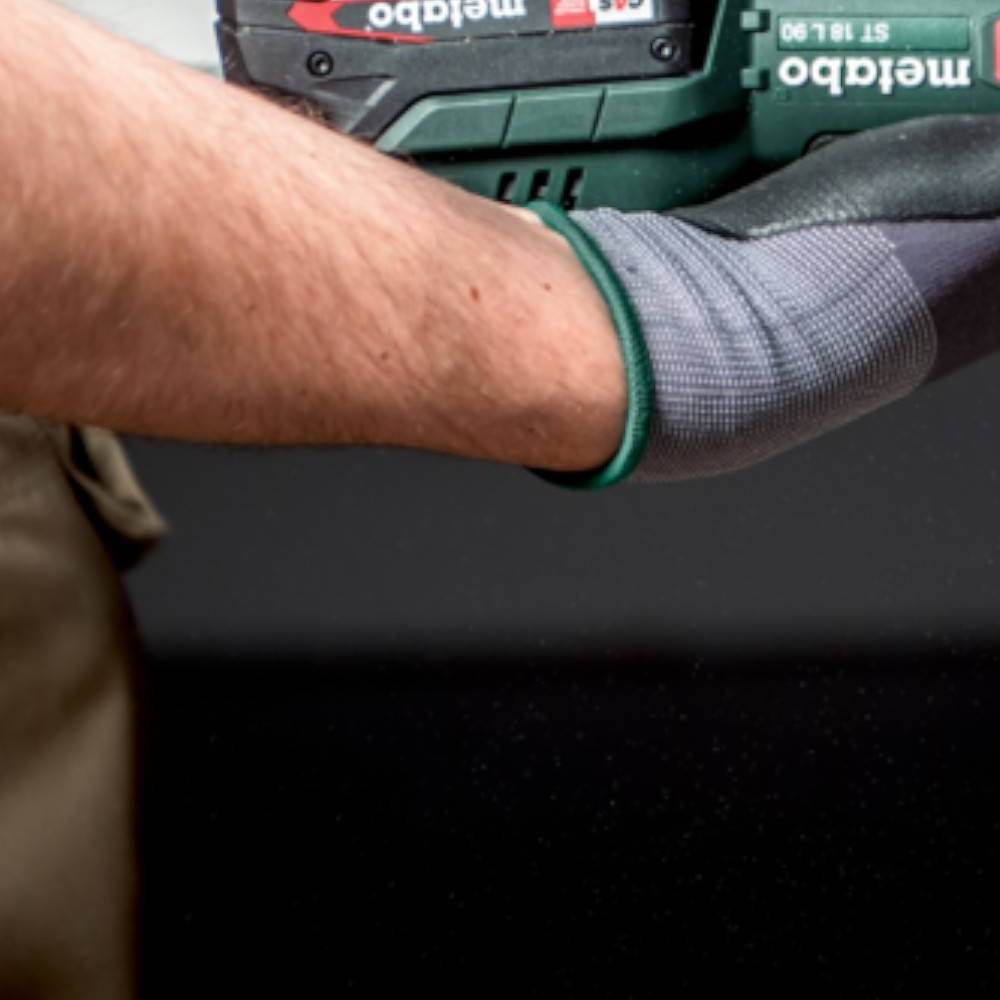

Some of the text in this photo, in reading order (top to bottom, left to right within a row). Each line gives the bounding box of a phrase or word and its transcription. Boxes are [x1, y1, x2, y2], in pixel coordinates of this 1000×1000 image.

[780, 23, 890, 43] ST 18 L 90
[779, 57, 971, 95] metabo
